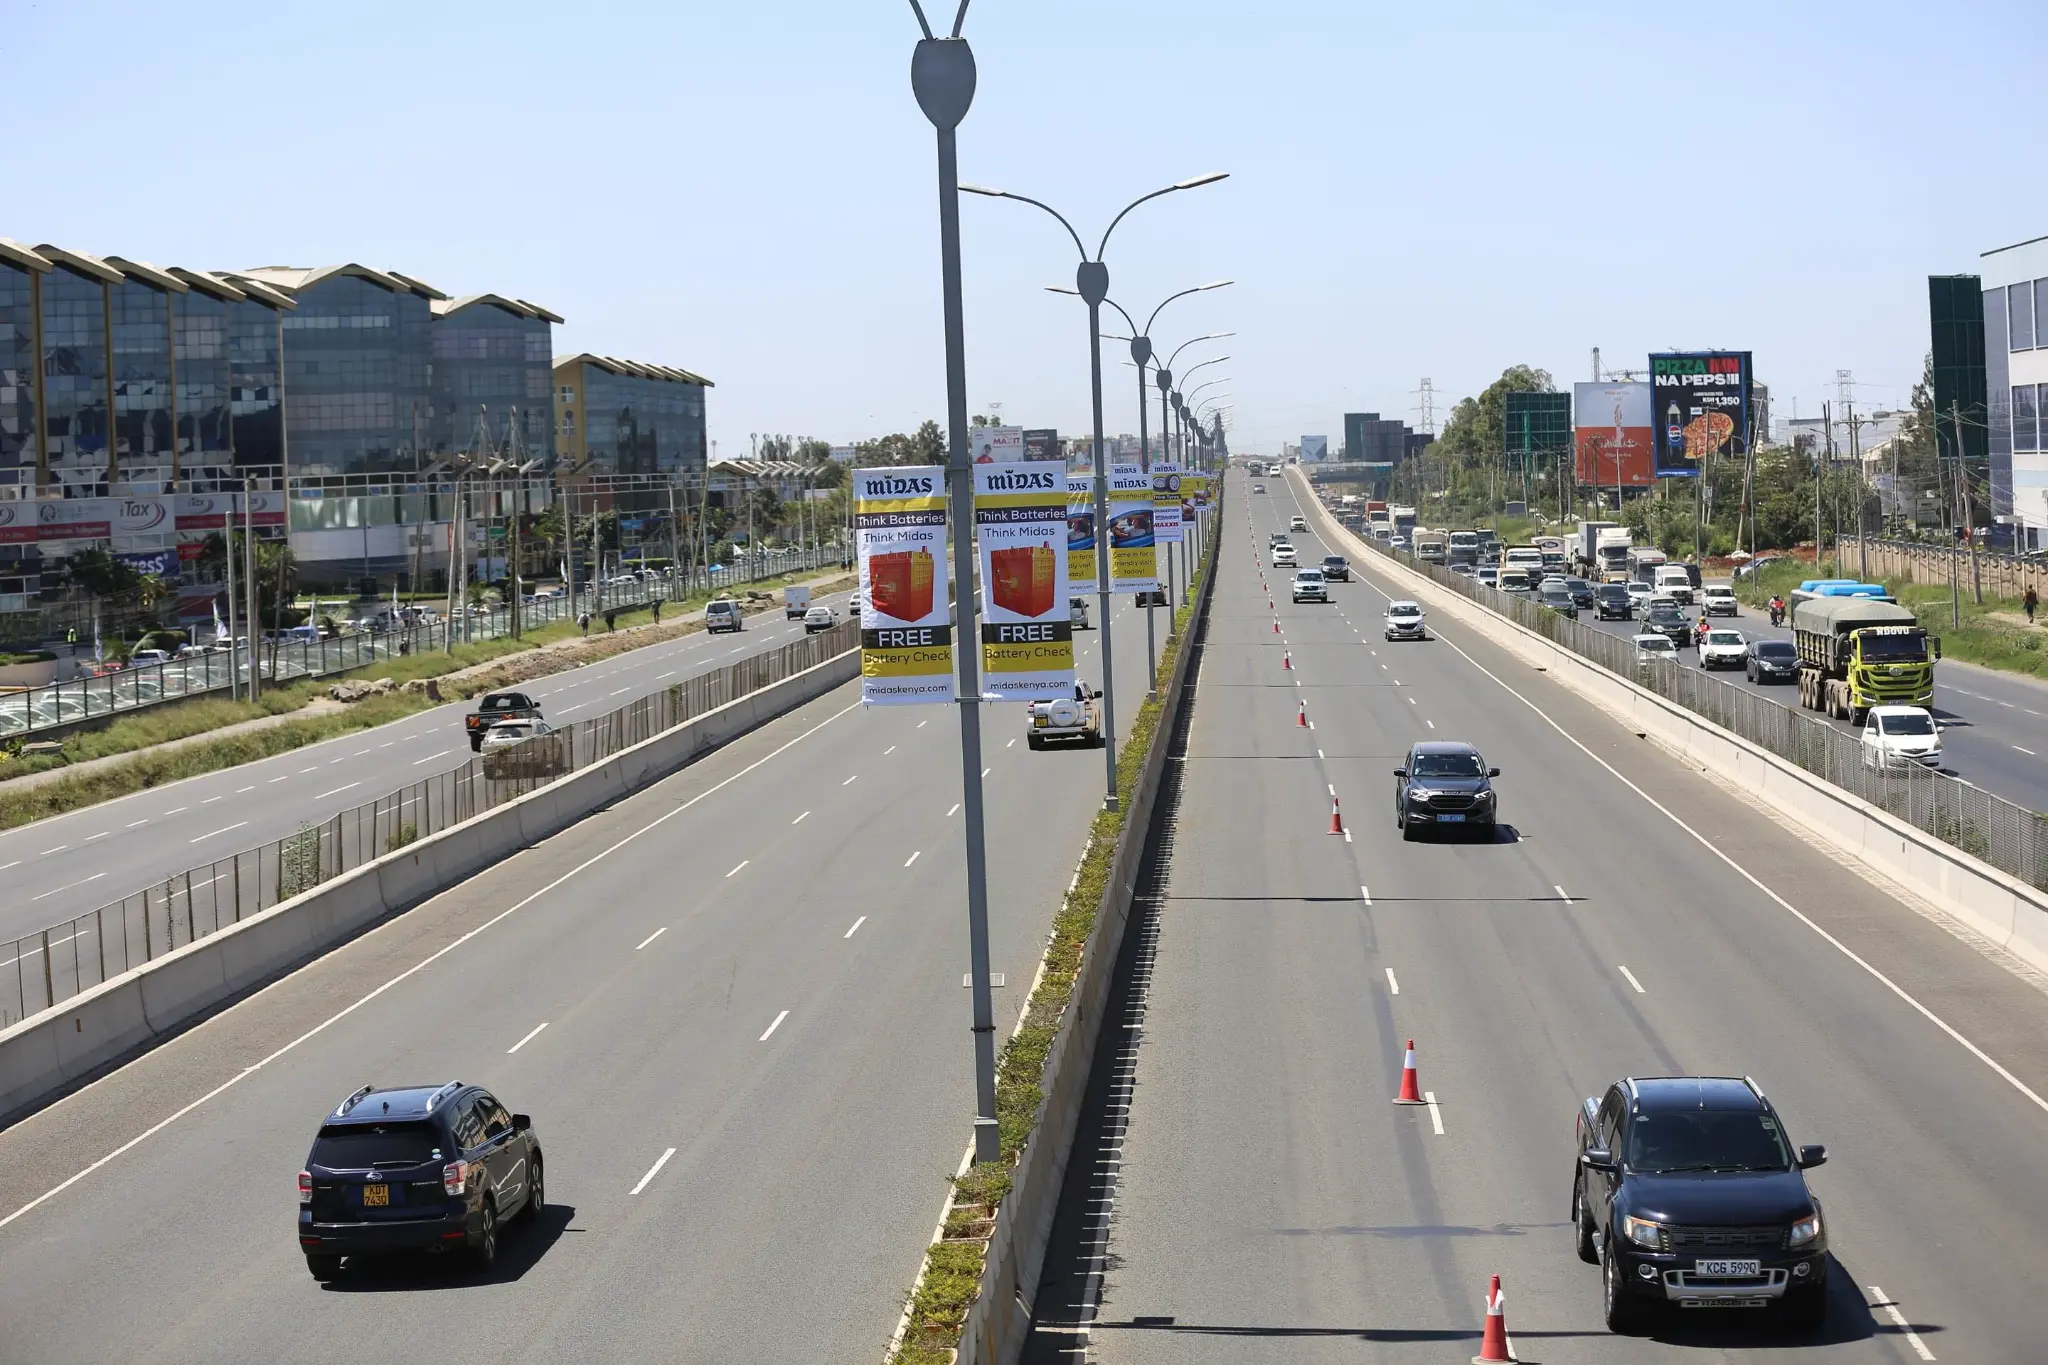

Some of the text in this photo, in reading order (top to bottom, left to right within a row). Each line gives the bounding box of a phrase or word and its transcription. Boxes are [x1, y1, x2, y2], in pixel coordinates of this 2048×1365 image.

[1654, 358, 1739, 374] PIZZA INN
[1655, 375, 1679, 386] NA
[1715, 397, 1740, 406] 1,350
[1067, 482, 1087, 491] DAS
[120, 501, 150, 517] iTax
[978, 508, 1066, 521] Think Batteries
[857, 513, 944, 526] Think Batteries
[864, 530, 933, 543] Think Midas
[985, 526, 1055, 538] Think Midas
[878, 629, 933, 646] FREE
[1000, 624, 1054, 642] FREE
[864, 650, 949, 665] Battery Check
[985, 646, 1071, 660] Battery Check
[869, 684, 947, 695] midaskenya.com
[990, 680, 1068, 691] midaskenya.com
[370, 1185, 386, 1195] KDT
[1706, 1262, 1757, 1274] KCG 599Q
